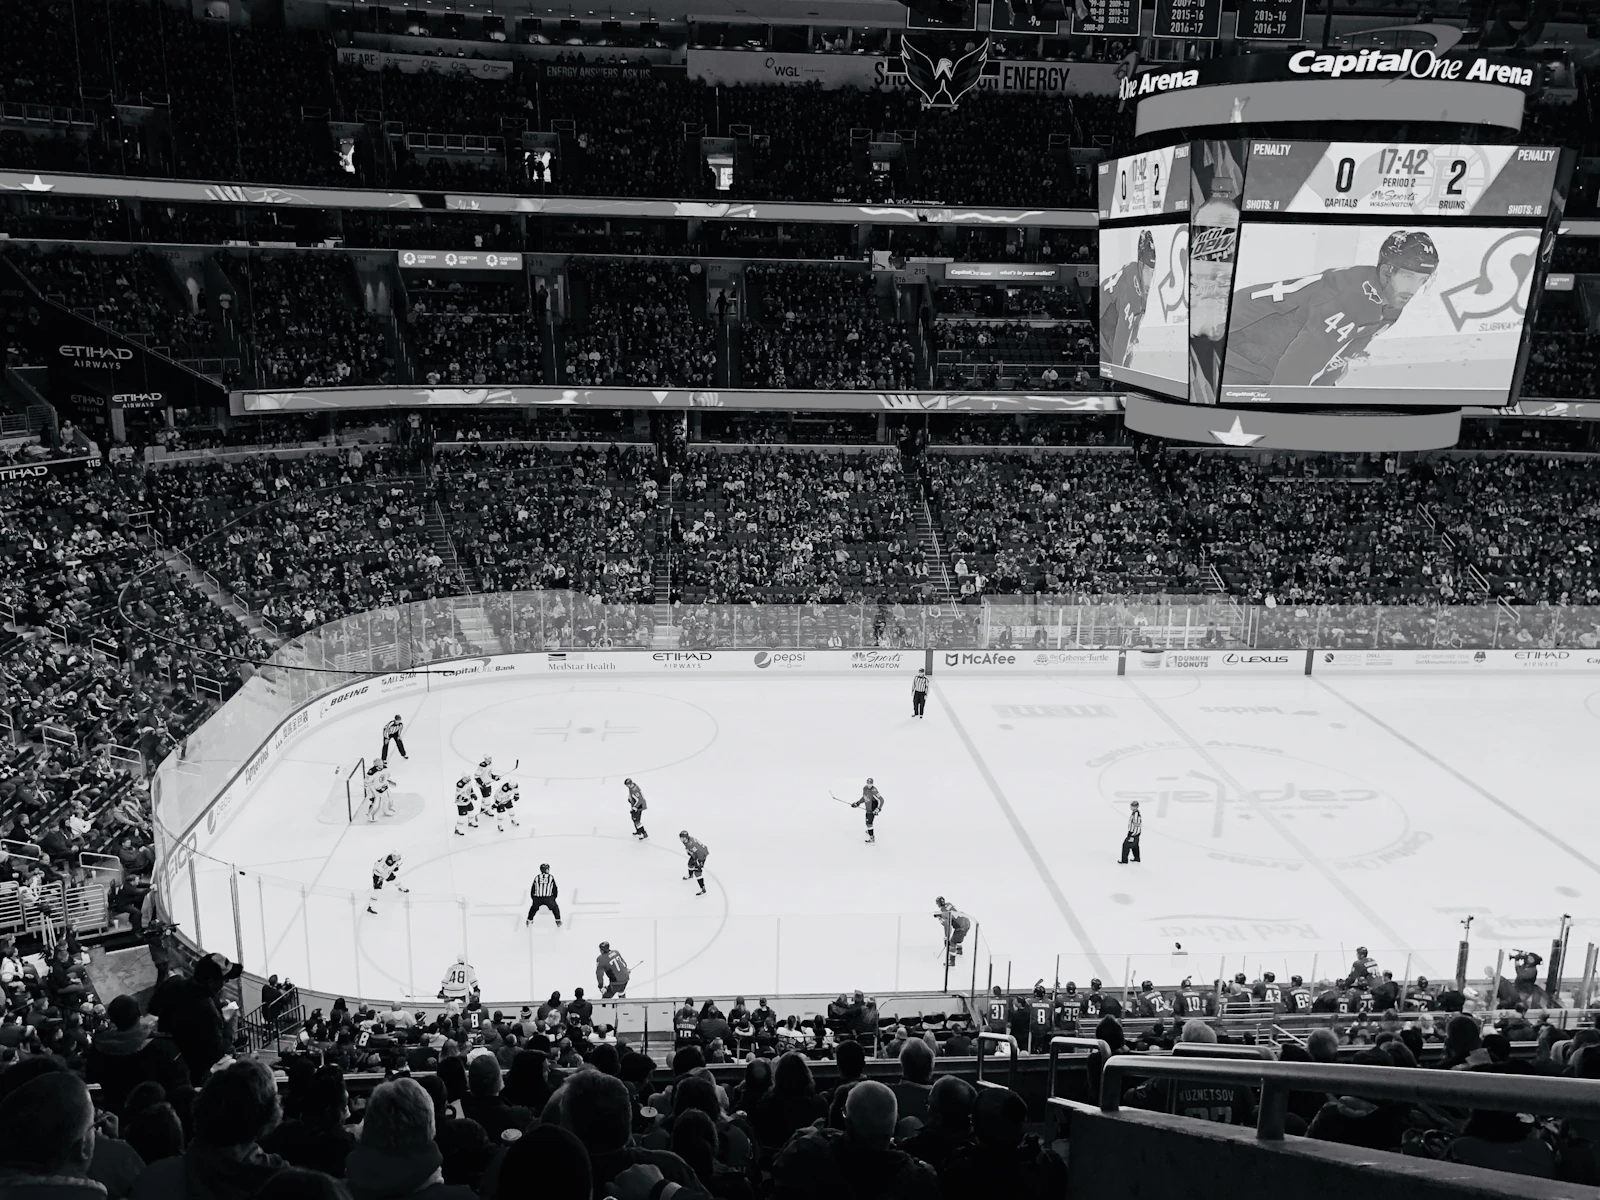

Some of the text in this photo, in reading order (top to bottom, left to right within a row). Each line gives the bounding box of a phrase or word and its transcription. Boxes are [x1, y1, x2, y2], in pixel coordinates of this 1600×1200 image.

[1171, 9, 1204, 20] 2015-16
[1254, 10, 1287, 21] 2015-16
[1170, 22, 1203, 33] 2016-17
[1253, 23, 1286, 34] 2016-17
[342, 52, 355, 64] WE
[546, 65, 577, 78] ENERGY
[622, 68, 638, 79] ASK
[774, 66, 800, 77] WGL
[1466, 57, 1533, 87] Arena
[1004, 66, 1071, 92] ENERGY
[1138, 69, 1199, 95] Arena
[1253, 144, 1291, 156] PENALTY
[1517, 149, 1556, 162] PENALTY
[1377, 148, 1429, 175] 17:42
[1154, 163, 1160, 196] 2
[1335, 157, 1356, 193] 0
[1446, 159, 1467, 195] 2
[1122, 170, 1127, 201] 0
[1382, 177, 1416, 187] PERIOD 2
[1384, 189, 1418, 201] Sports
[1246, 199, 1272, 210] SHOTS:
[1325, 198, 1358, 208] CAPITALS
[1438, 200, 1465, 210] BRUINS
[1507, 204, 1533, 215] SHOTS:
[1124, 302, 1135, 330] 44
[1324, 311, 1356, 343] 44
[58, 345, 134, 360] ETIHAD
[73, 360, 121, 370] AIRWAYS
[70, 394, 105, 406] ETIHAD
[111, 392, 163, 403] ETIHAD
[86, 459, 102, 468] 115
[0, 466, 49, 481] TIHAD
[652, 652, 713, 661] ETIHAD
[773, 651, 806, 664] pepsi
[866, 651, 903, 663] Sports
[962, 652, 1017, 665] McAfee
[1058, 653, 1086, 662] Greene
[1086, 653, 1109, 661] Turtle
[1240, 655, 1289, 663] LEXUS
[1514, 651, 1570, 660] ETIHAD
[548, 662, 616, 670] MedStar Health
[330, 685, 369, 707] BOEING
[1158, 922, 1325, 943] Red River
[448, 970, 466, 984] 48
[1265, 989, 1281, 1004] 43
[1186, 996, 1200, 1012] 10
[991, 1004, 1004, 1020] 31
[1037, 1008, 1046, 1025] 8
[1063, 1007, 1080, 1022] 39
[470, 1012, 480, 1029] 8
[358, 1031, 370, 1047] 8
[1178, 1088, 1235, 1102] KUZNETSOV
